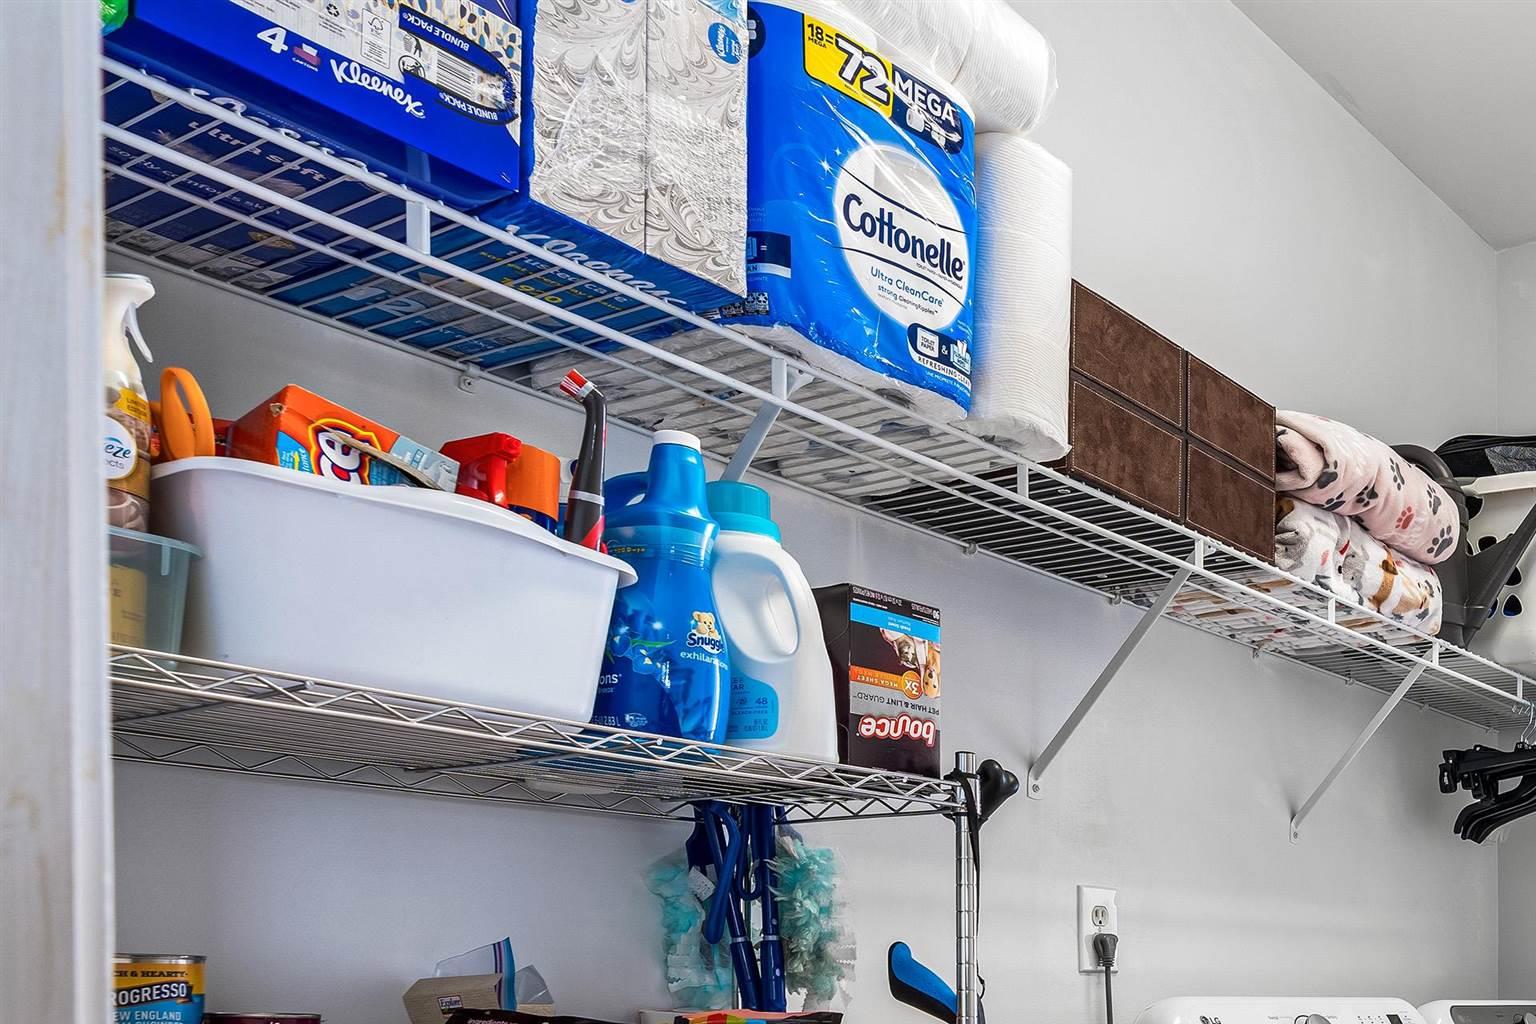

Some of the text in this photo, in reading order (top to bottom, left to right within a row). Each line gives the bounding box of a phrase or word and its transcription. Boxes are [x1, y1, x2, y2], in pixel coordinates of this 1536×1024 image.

[256, 26, 289, 55] 4
[433, 28, 470, 52] BUNDLE
[807, 36, 827, 50] MEGA
[835, 32, 890, 105] 72
[330, 58, 424, 117] Kleenex
[893, 70, 958, 128] MEGA
[466, 103, 499, 121] BUNDLE
[842, 193, 964, 281] Cottonelle
[870, 265, 893, 286] Ultra
[877, 284, 898, 301] strong
[857, 691, 940, 716] PET HAIR & LINT GUARD
[859, 713, 936, 746] bounce
[112, 982, 187, 1006] ROGRESSO
[113, 1010, 182, 1021] EW ENGLAND
[1209, 1016, 1222, 1024] LG
